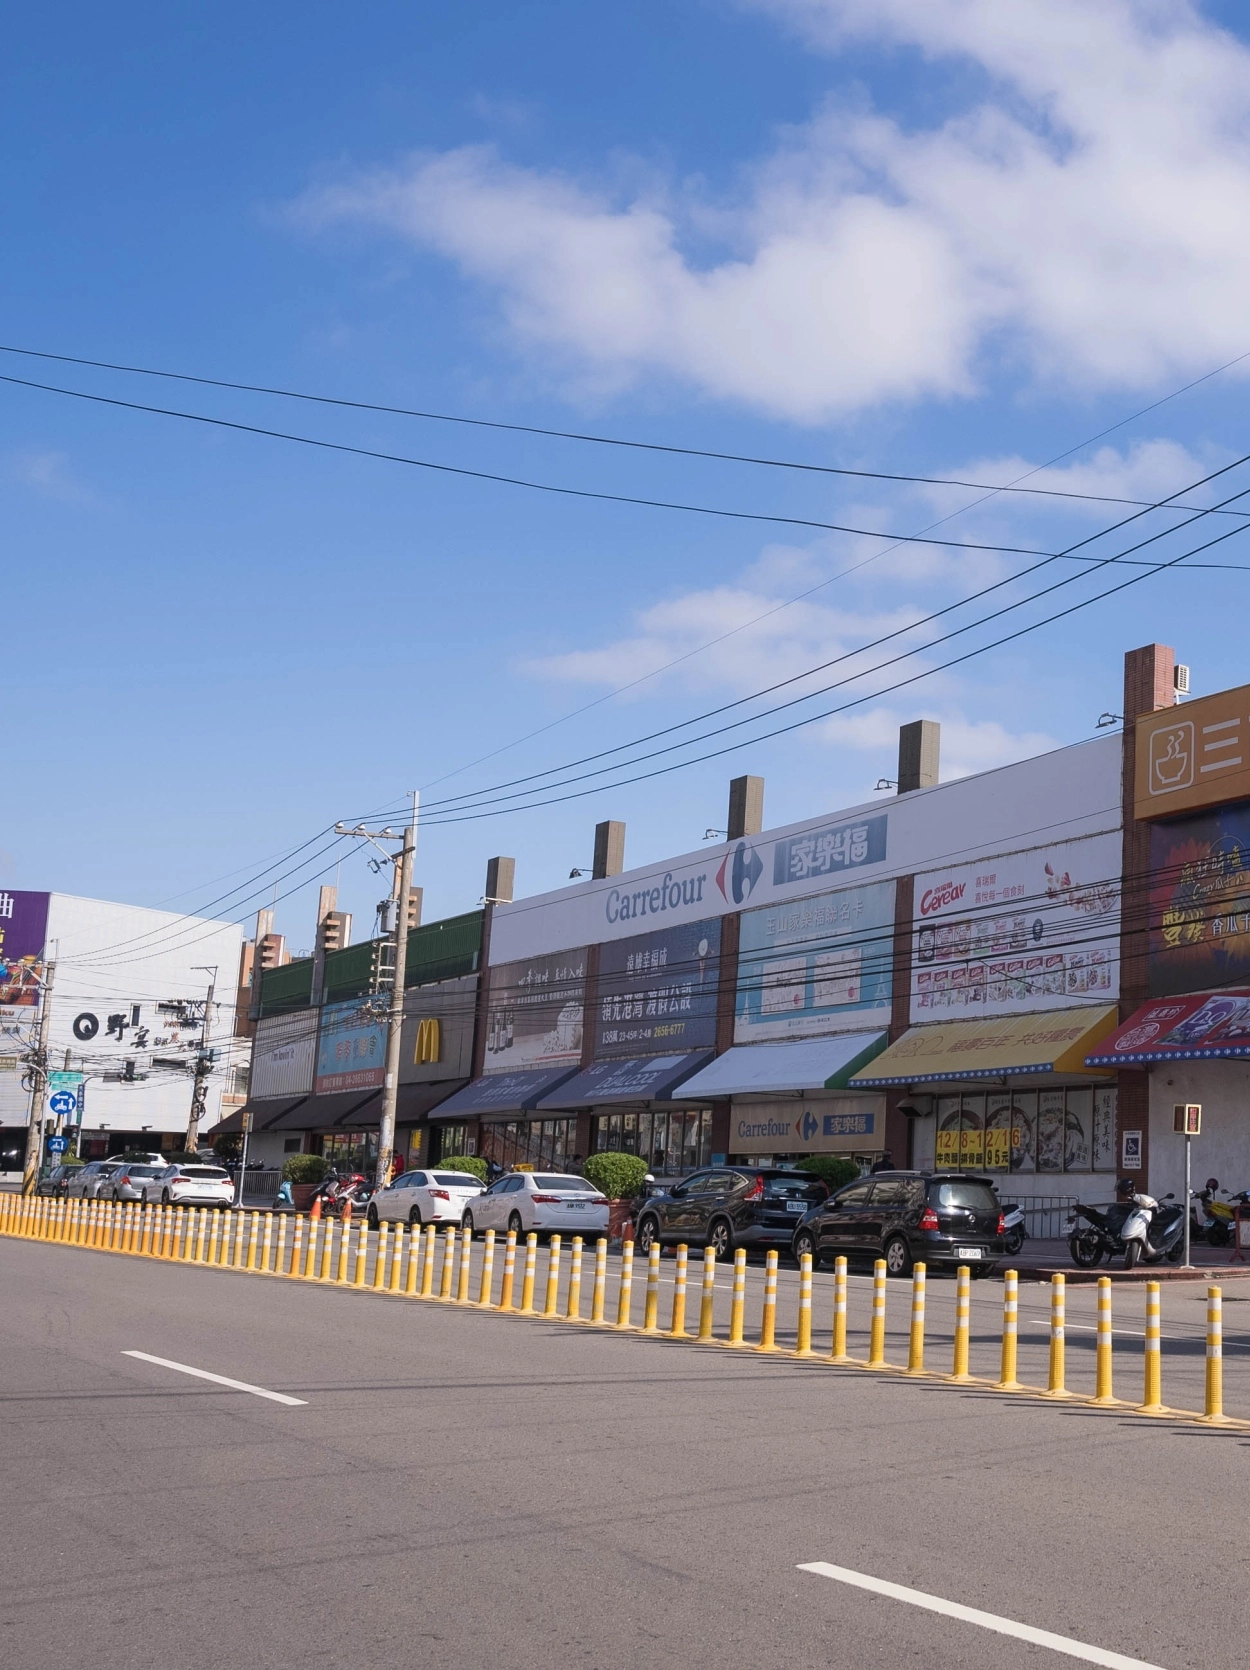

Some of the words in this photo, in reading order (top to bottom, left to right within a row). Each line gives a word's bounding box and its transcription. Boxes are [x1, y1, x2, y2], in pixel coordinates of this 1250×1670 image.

[790, 826, 869, 877] 家樂福
[605, 871, 707, 924] Carrefour
[653, 1023, 685, 1038] 2656-6777
[738, 1118, 790, 1138] Carrefour
[830, 1116, 866, 1134] 家樂福
